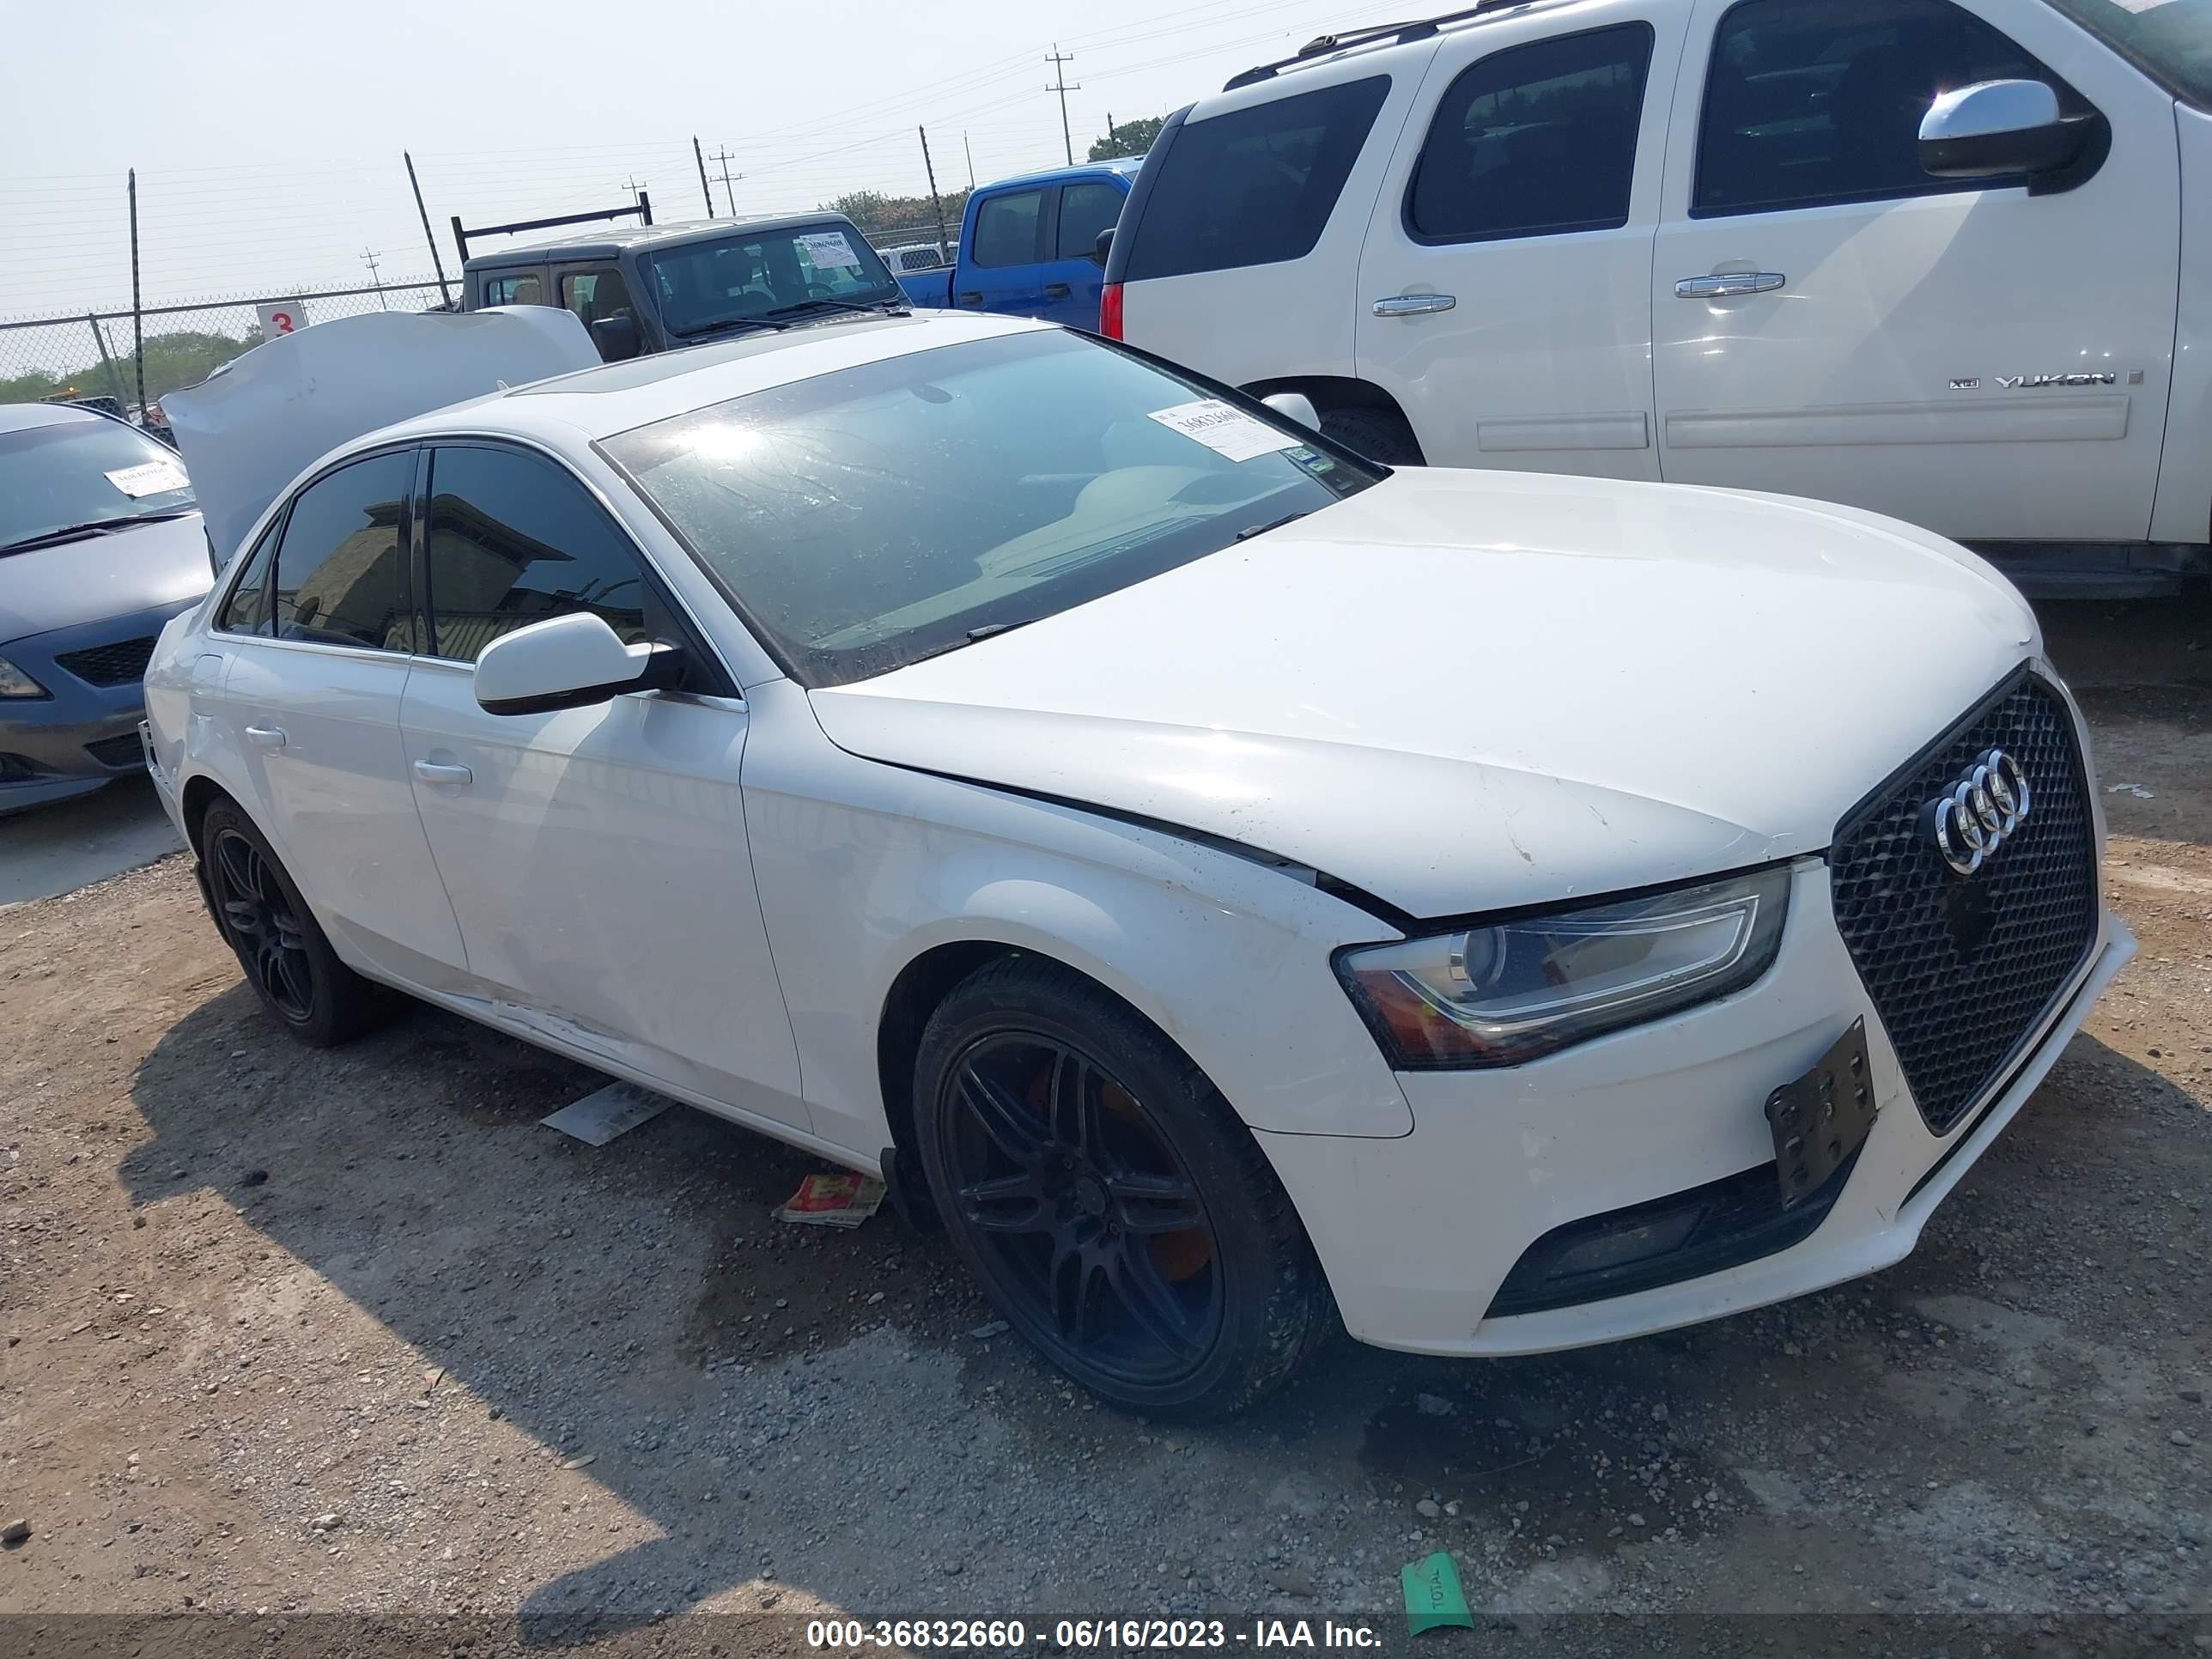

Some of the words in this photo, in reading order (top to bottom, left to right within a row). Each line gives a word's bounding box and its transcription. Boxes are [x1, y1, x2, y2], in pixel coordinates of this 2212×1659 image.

[271, 313, 295, 333] 3
[1994, 372, 2117, 389] YUKON
[1176, 410, 1243, 432] 36832660
[1429, 1567, 1444, 1610] TOTAL
